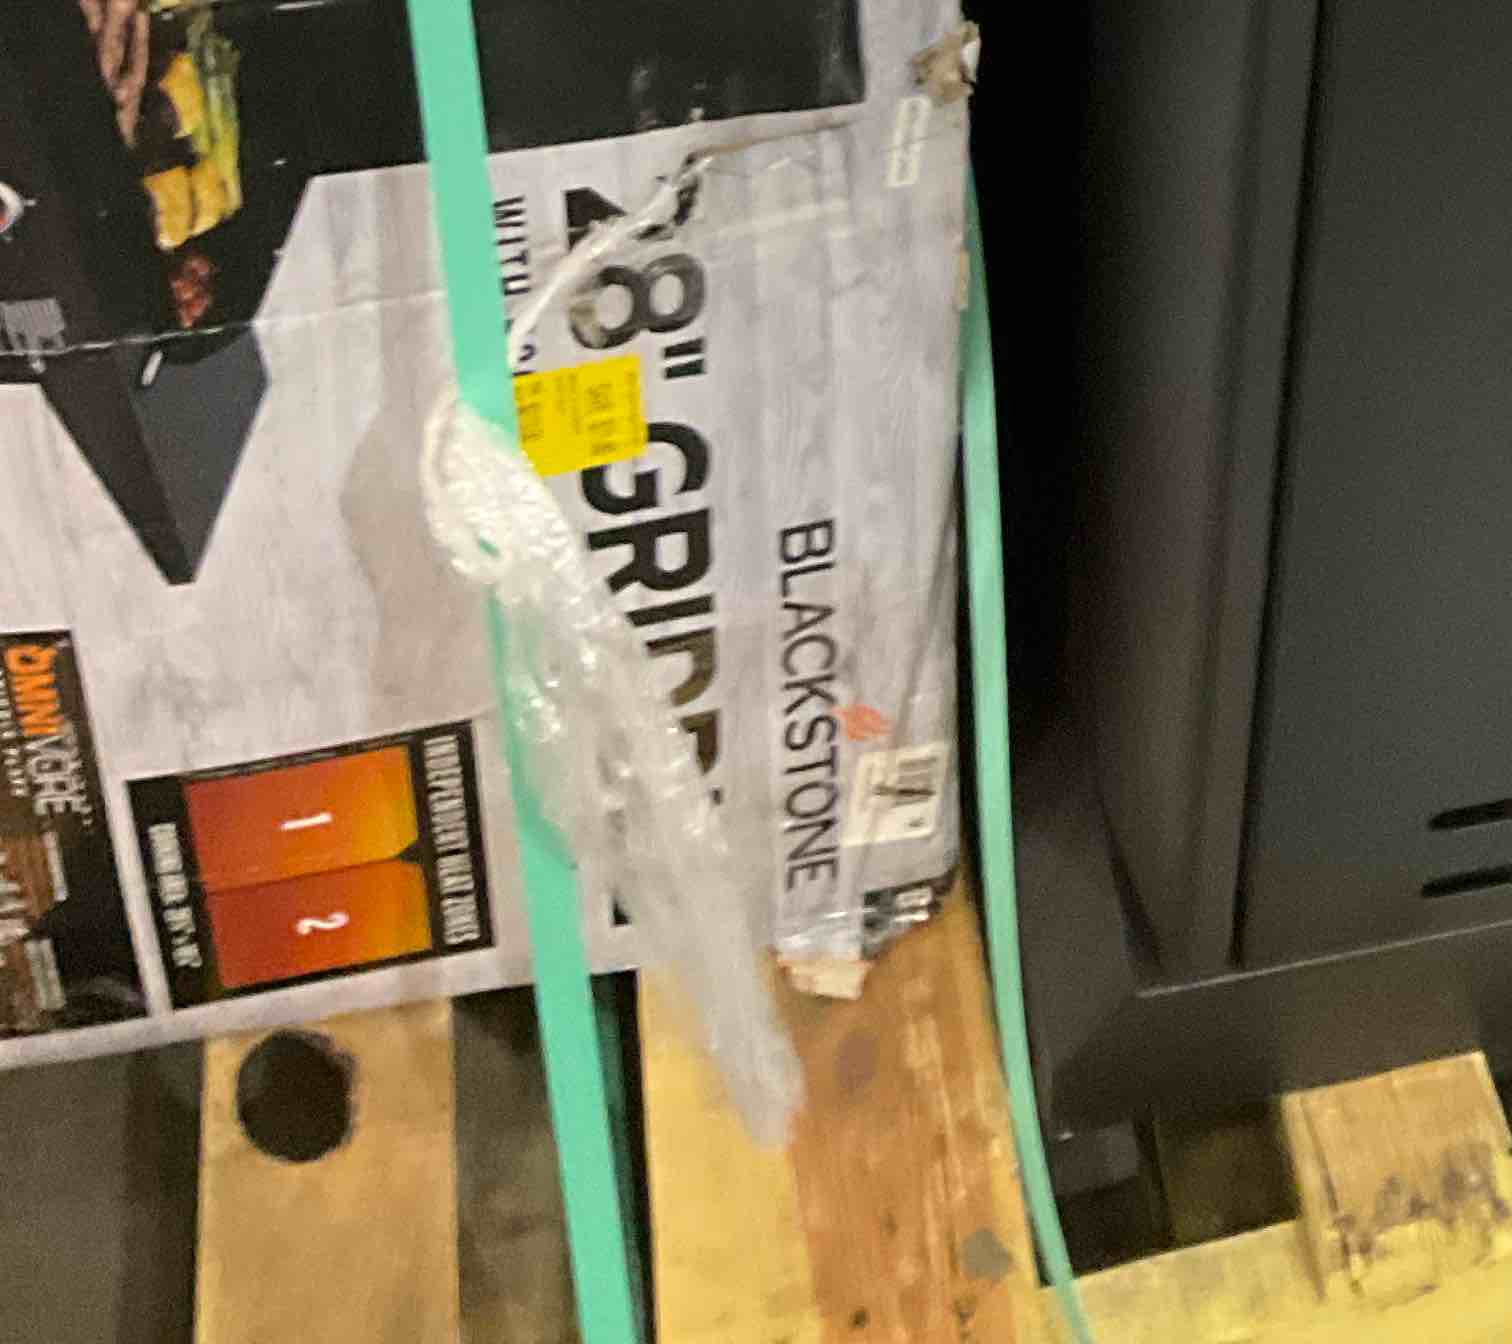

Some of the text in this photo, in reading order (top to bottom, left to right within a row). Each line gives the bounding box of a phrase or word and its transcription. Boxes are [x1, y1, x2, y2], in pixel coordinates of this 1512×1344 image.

[778, 518, 839, 893] BLACKSTONE
[279, 811, 334, 831] 1
[296, 912, 350, 936] 2
